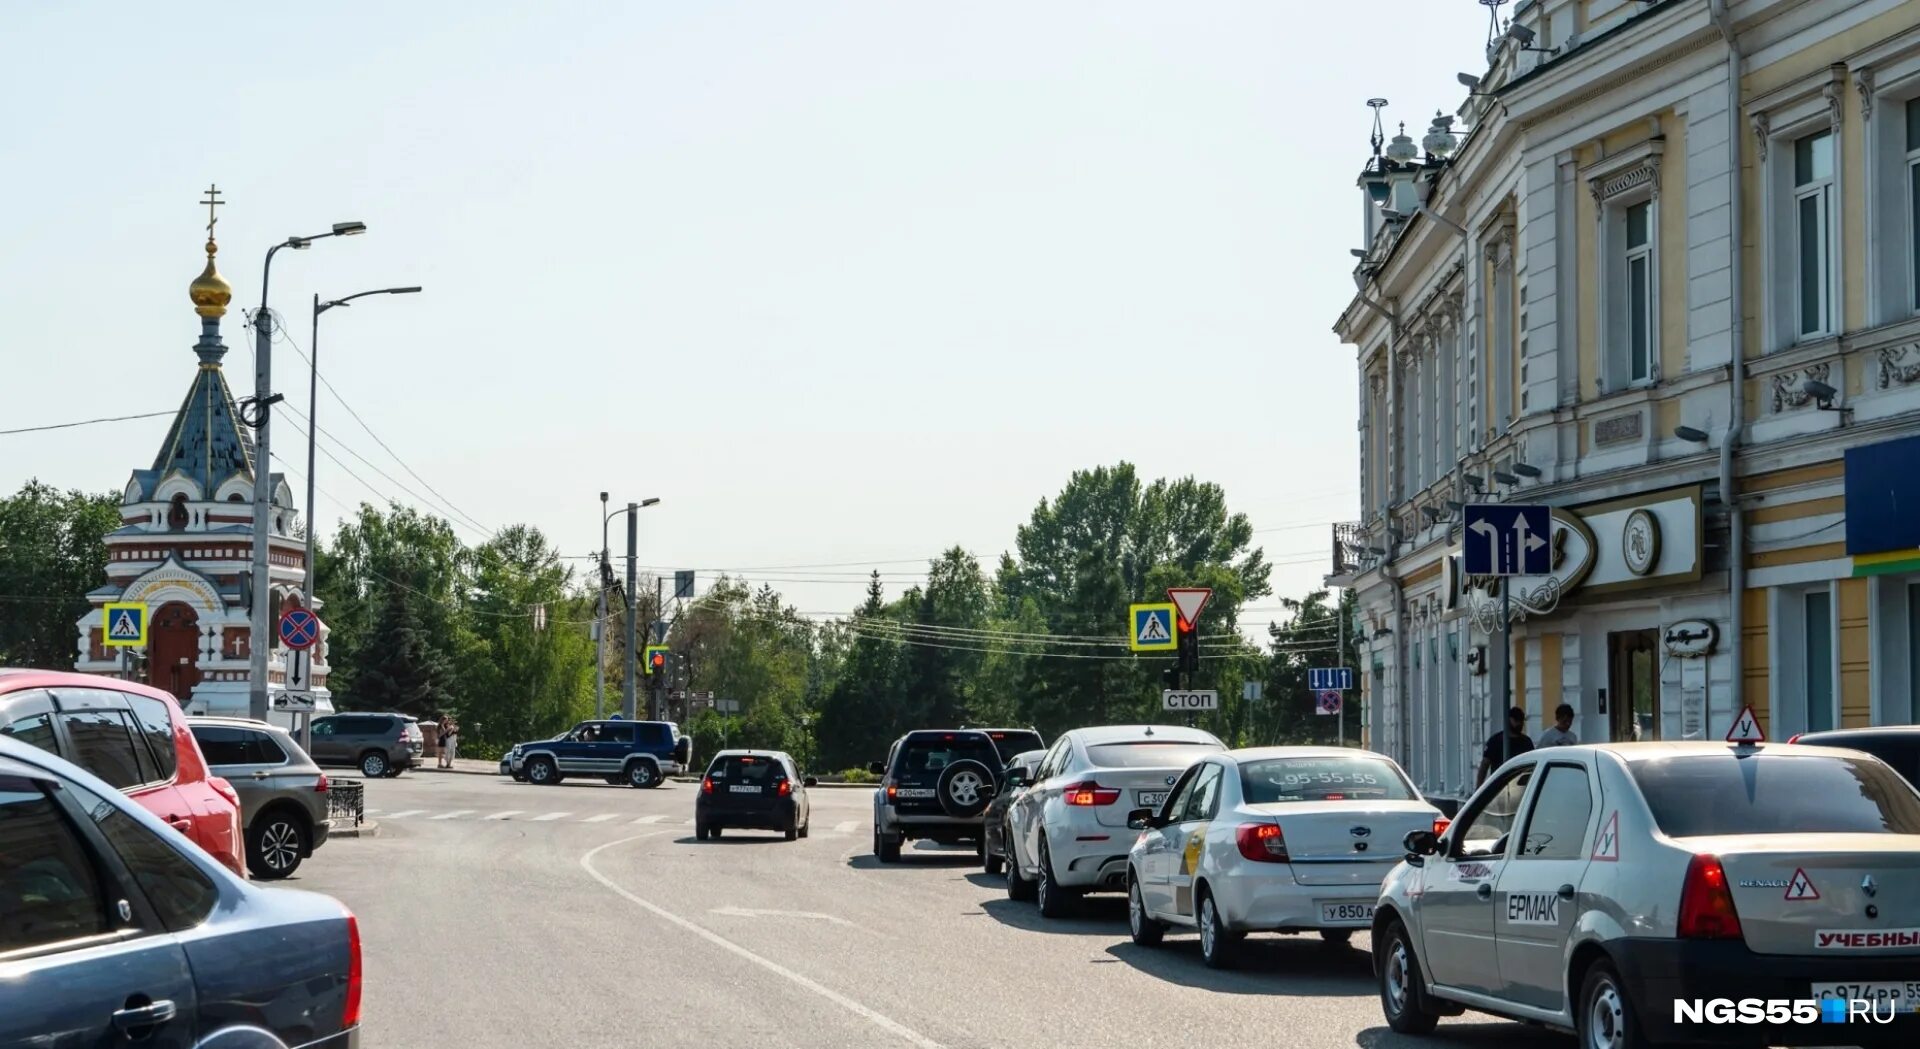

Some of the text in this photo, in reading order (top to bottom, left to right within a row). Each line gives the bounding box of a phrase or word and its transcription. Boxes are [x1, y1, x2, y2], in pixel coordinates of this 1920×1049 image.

[1168, 695, 1211, 707] СТОП
[1284, 772, 1377, 785] 95-55-55
[1508, 895, 1558, 921] ЕРМАК
[1818, 931, 1920, 947] УЧЕБНЫ
